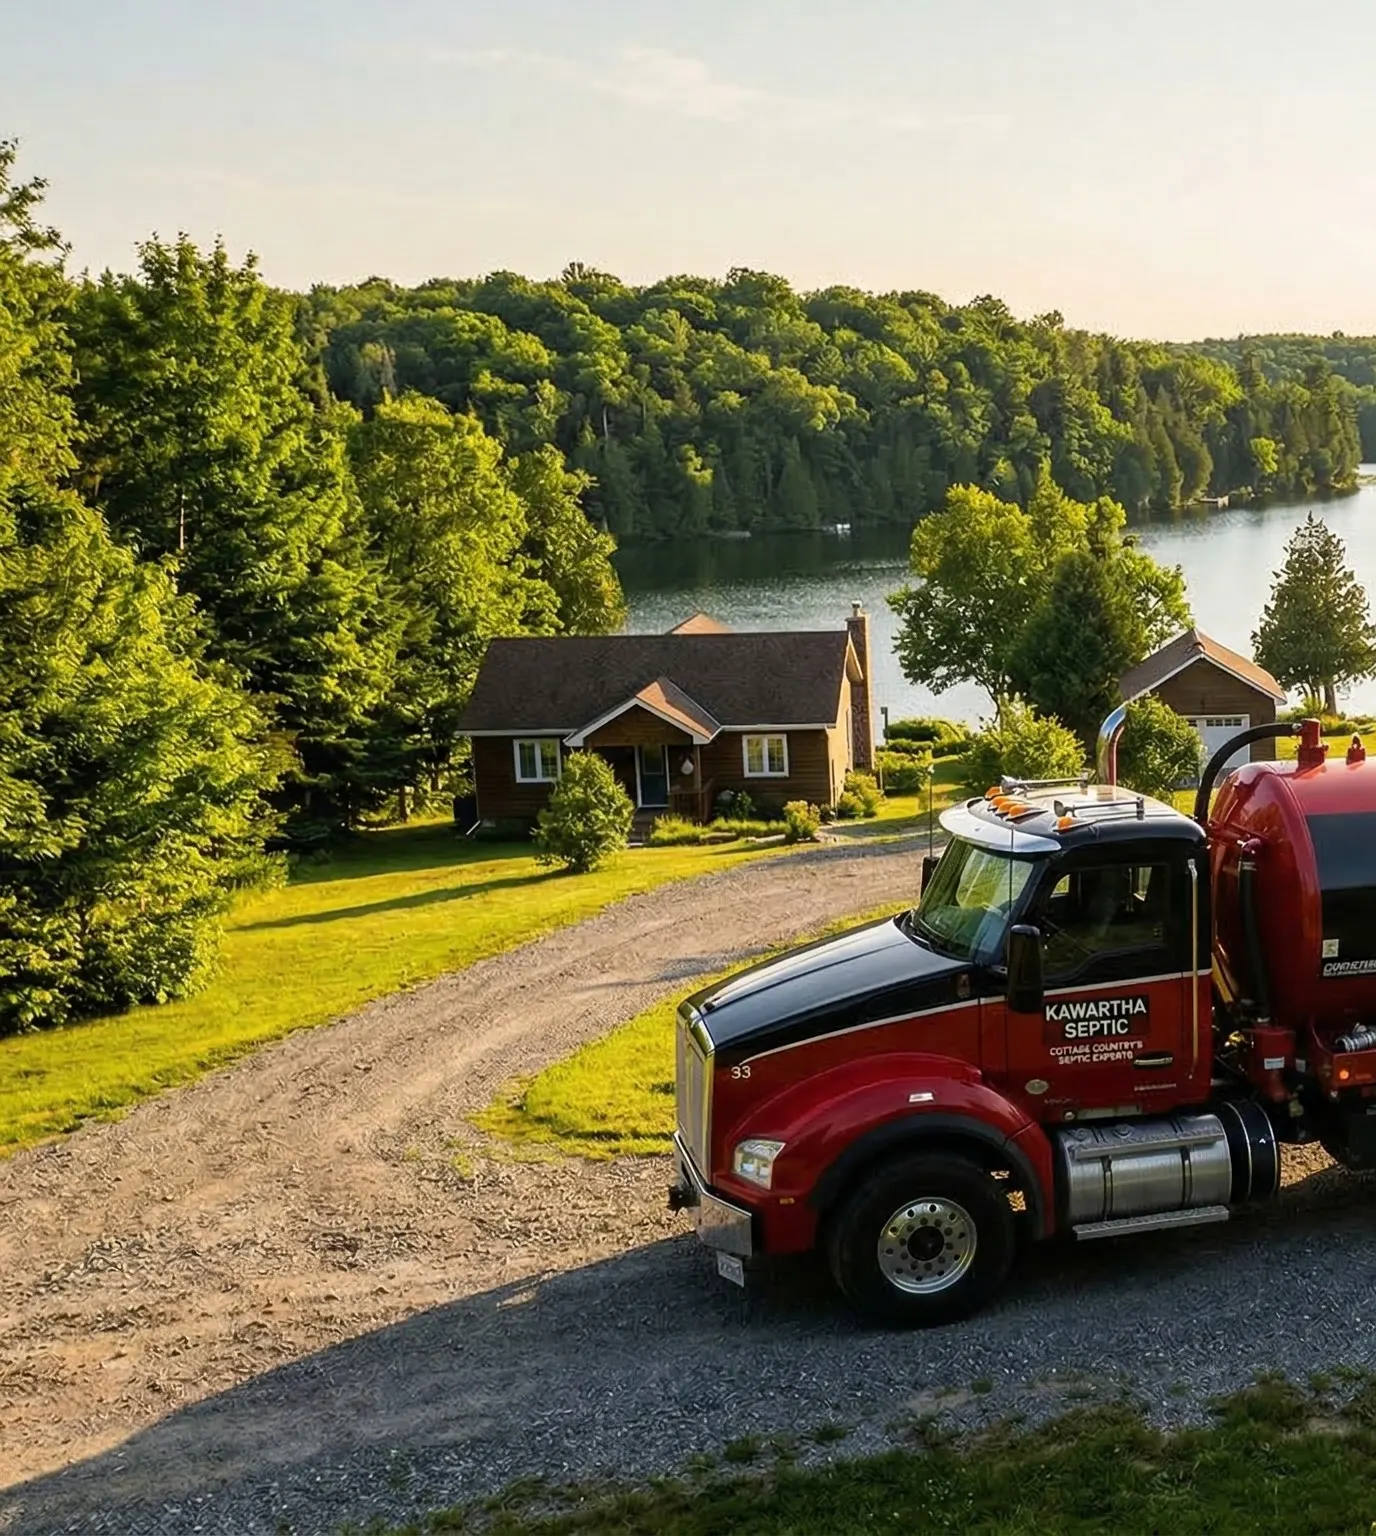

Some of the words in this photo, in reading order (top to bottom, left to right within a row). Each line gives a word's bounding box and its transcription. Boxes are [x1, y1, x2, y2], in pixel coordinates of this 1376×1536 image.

[1045, 998, 1147, 1021] KAWARTHA
[1064, 1018, 1129, 1039] SEPTIC
[731, 1065, 751, 1079] 33
